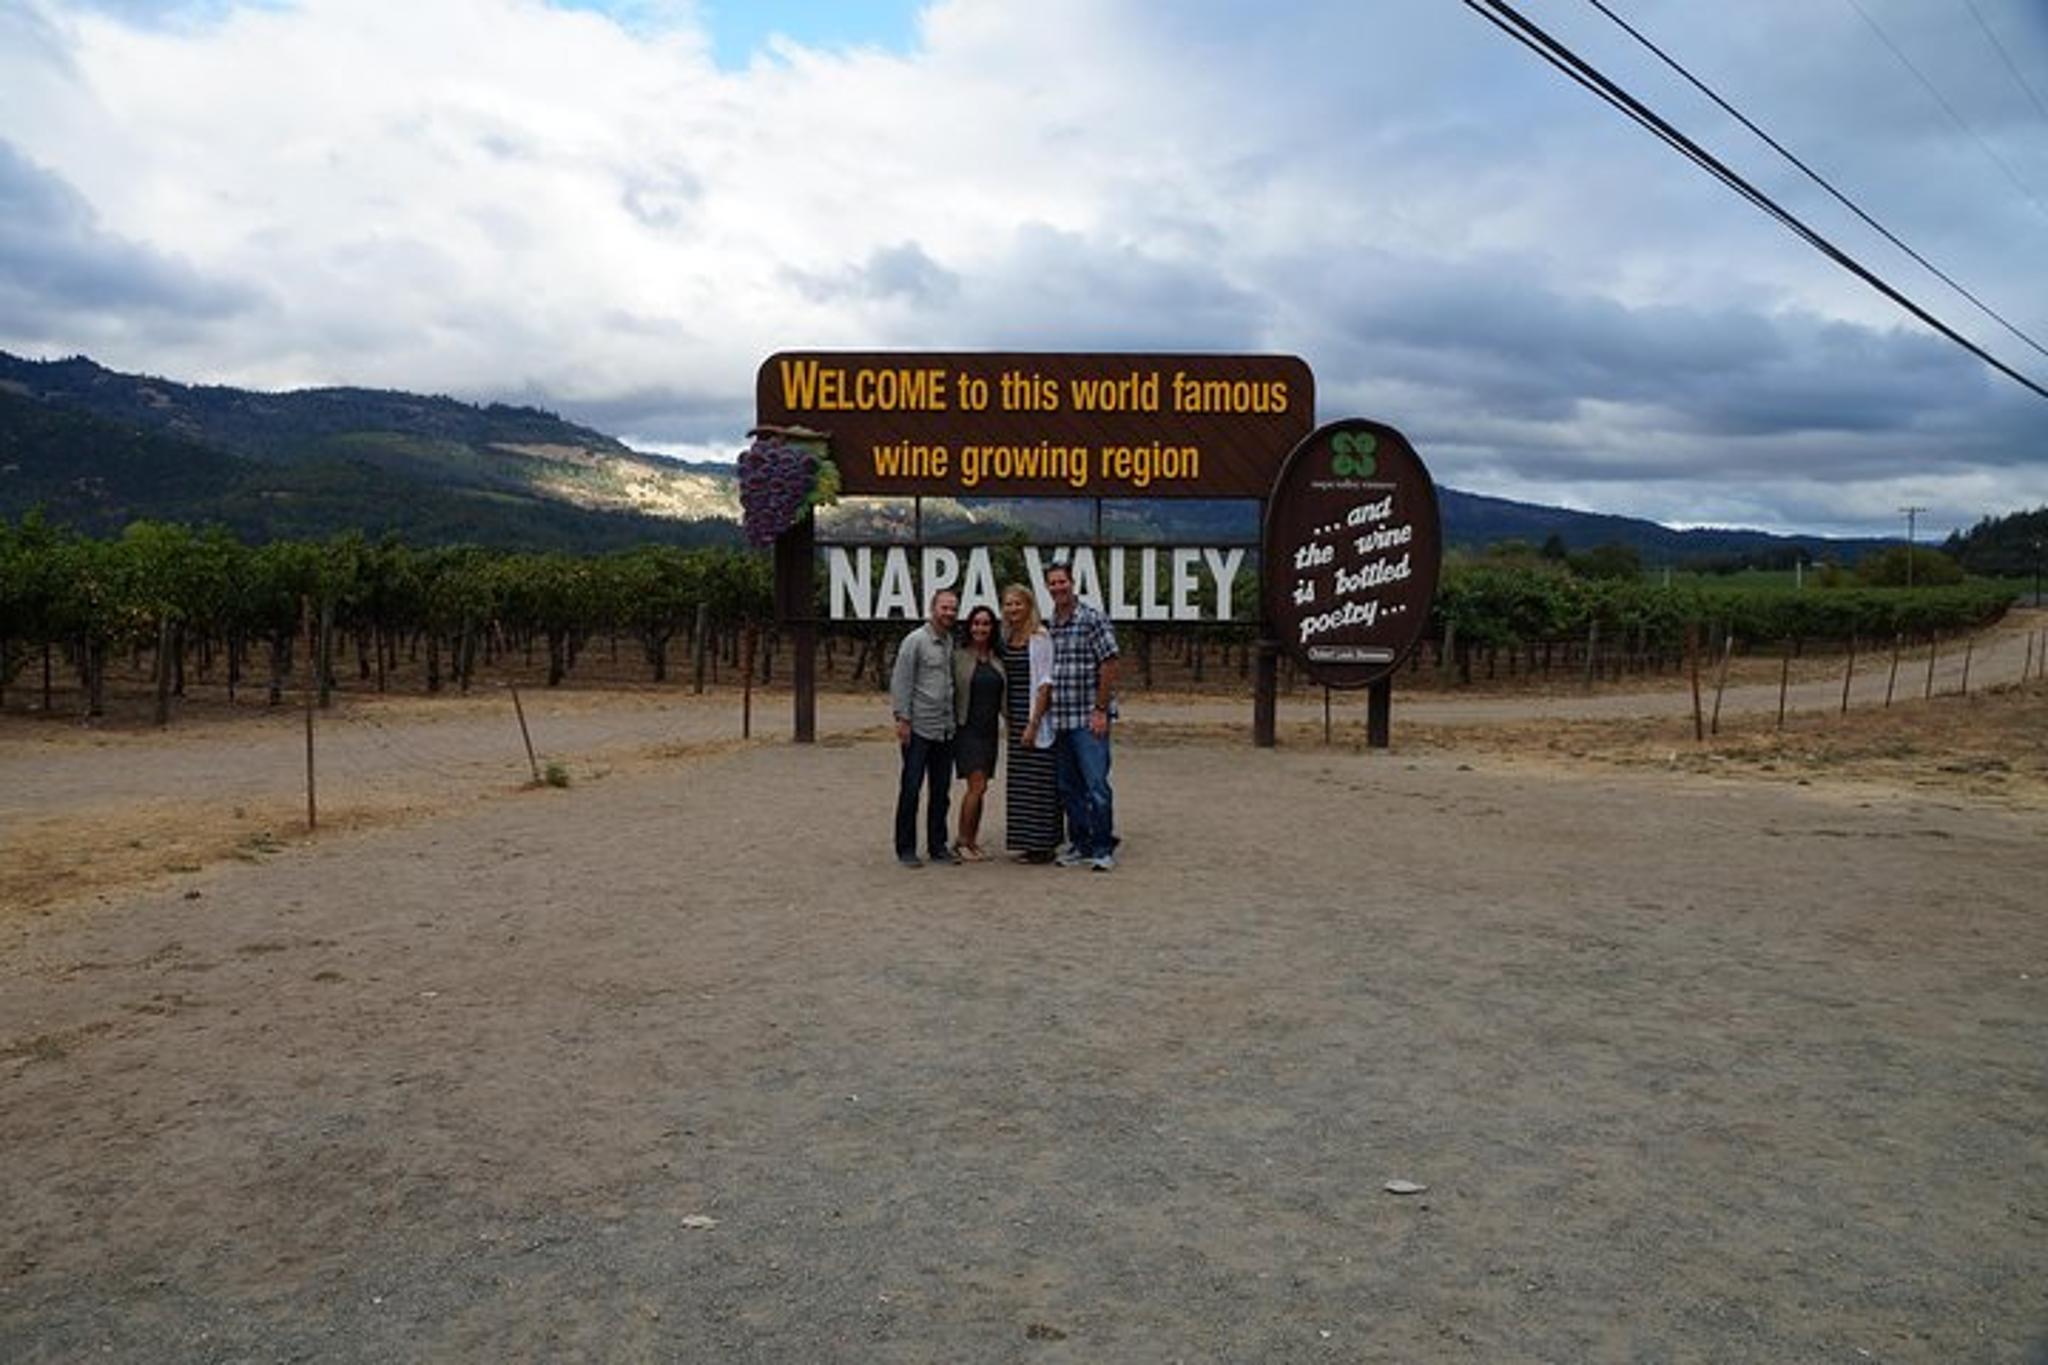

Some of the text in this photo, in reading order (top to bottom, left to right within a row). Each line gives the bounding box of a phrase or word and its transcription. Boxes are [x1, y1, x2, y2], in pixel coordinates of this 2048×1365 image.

[780, 360, 1288, 413] WELCOME to this world famous
[873, 440, 1199, 487] wine growing region
[1294, 523, 1412, 569] the wine
[829, 546, 1246, 621] NAPA VALLEY
[1292, 553, 1412, 604] is bottled
